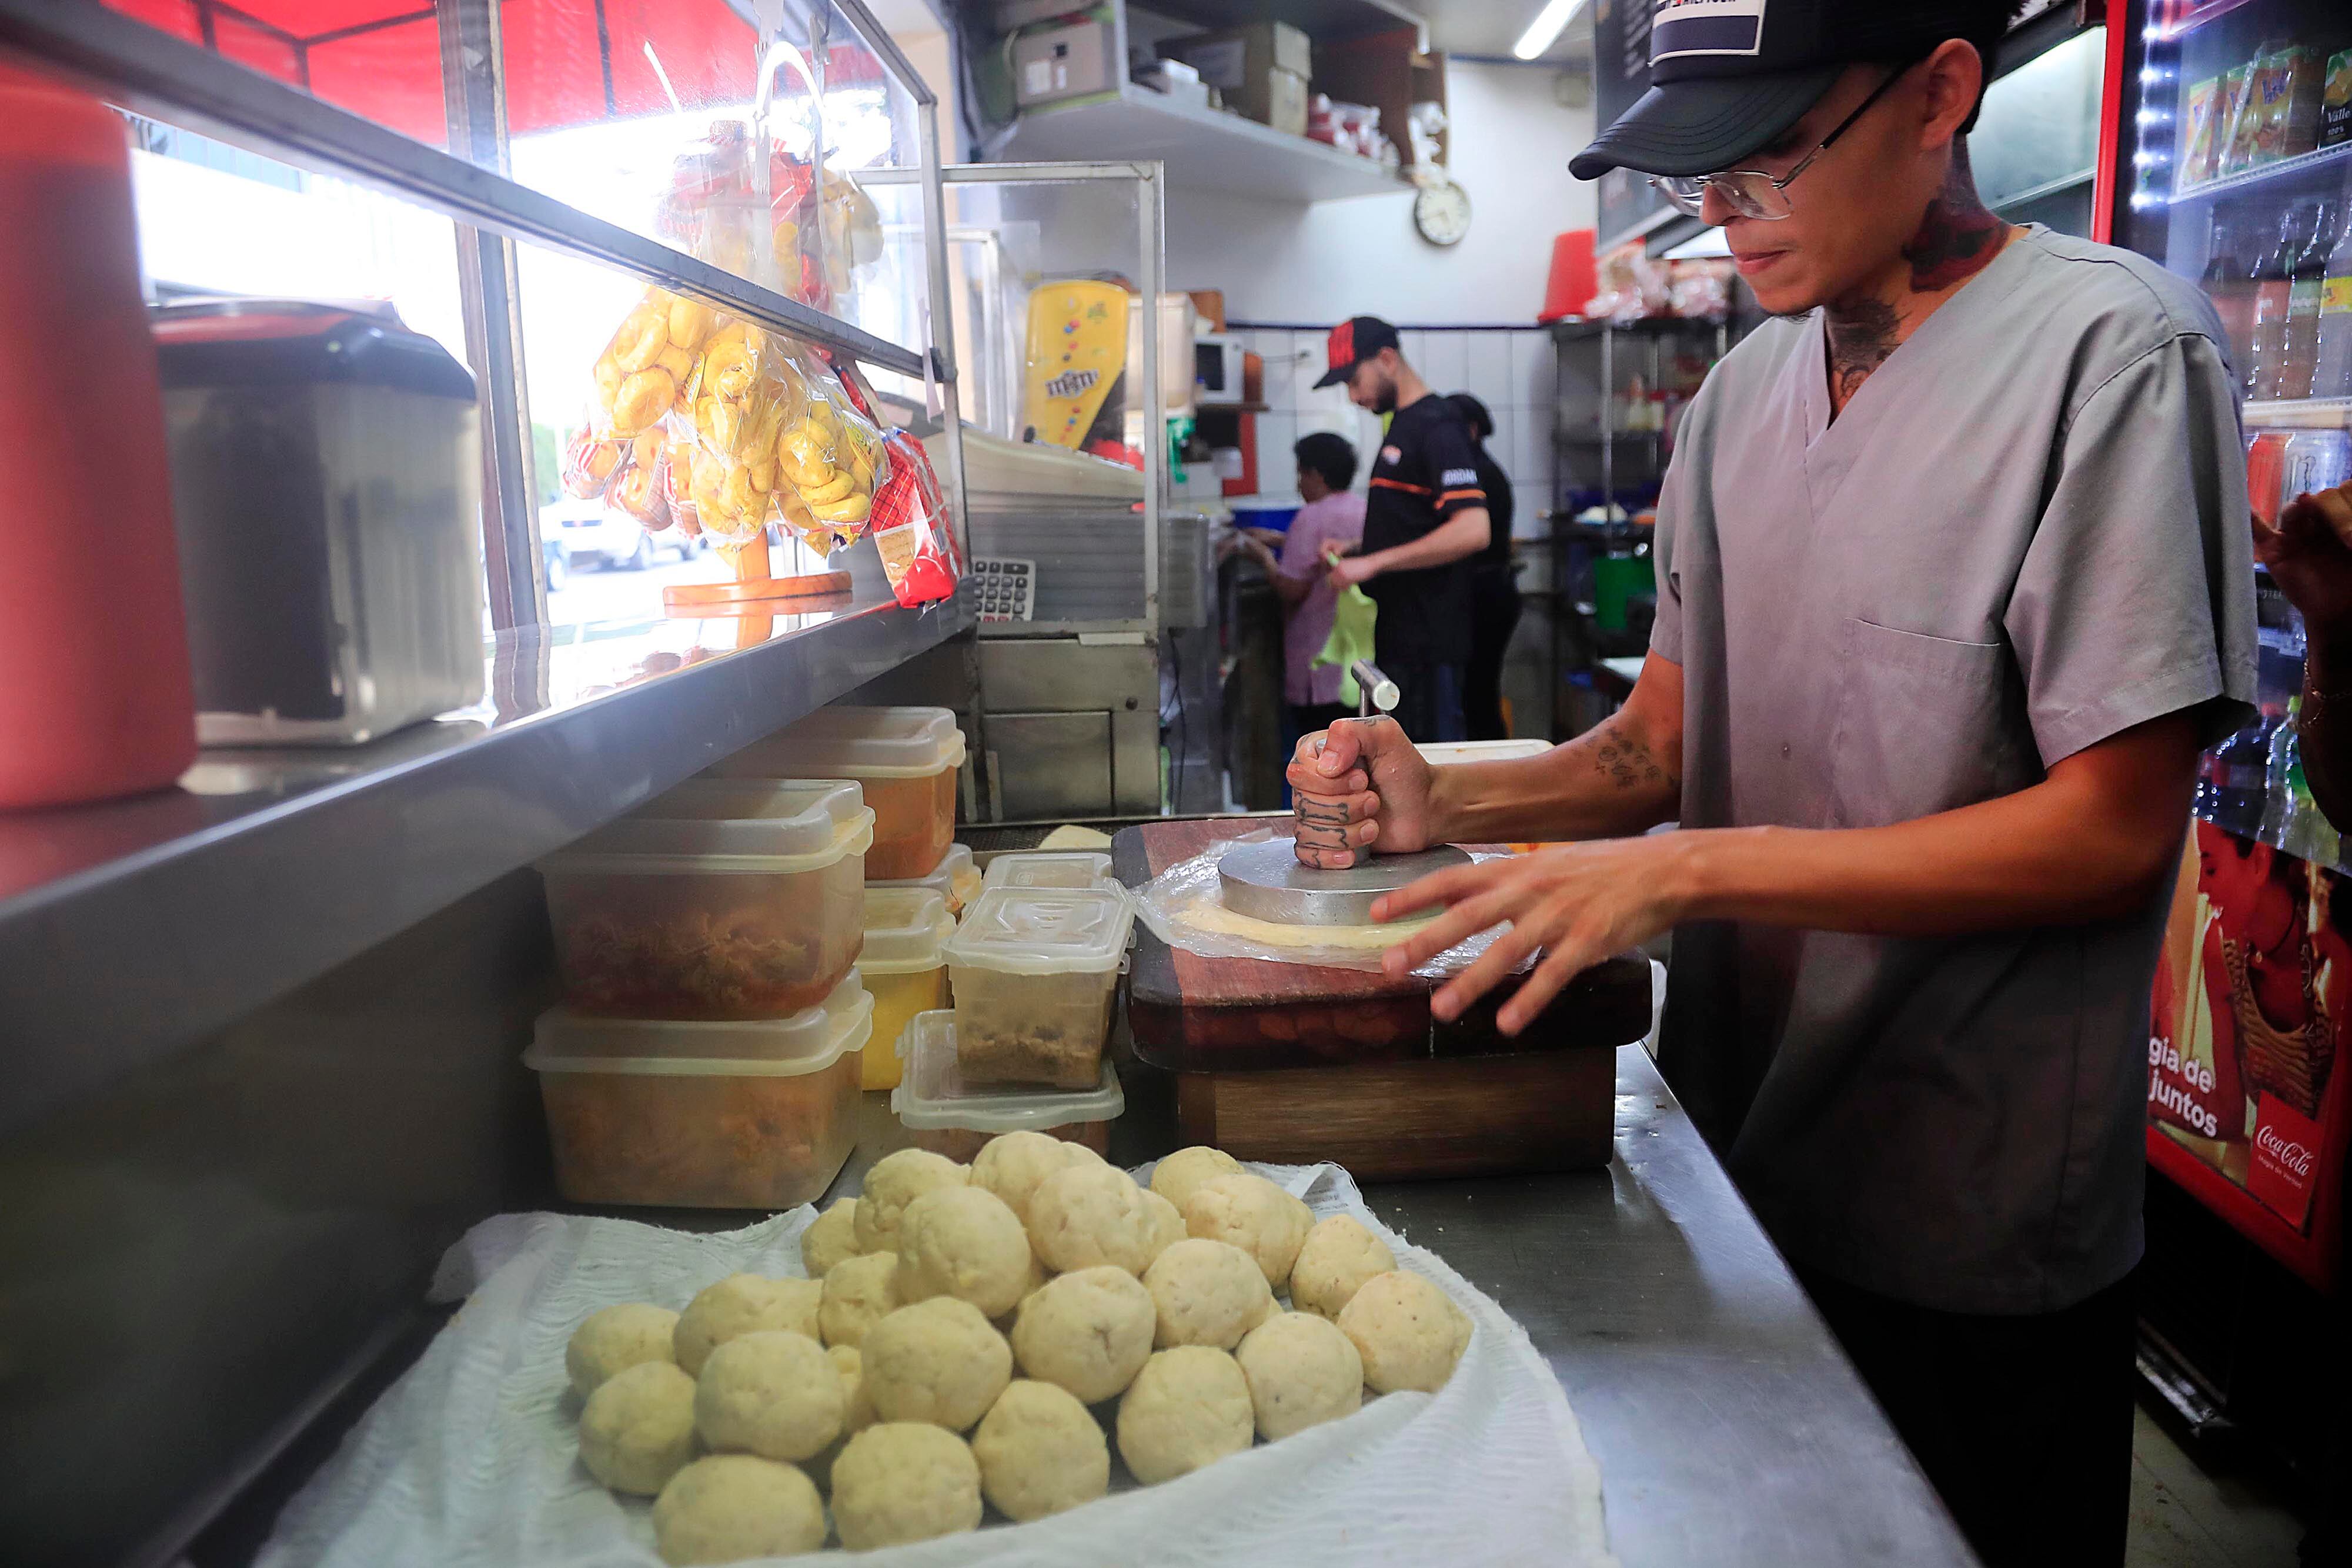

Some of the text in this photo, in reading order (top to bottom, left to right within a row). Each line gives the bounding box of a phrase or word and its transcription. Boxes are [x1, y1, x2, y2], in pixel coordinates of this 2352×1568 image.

[2149, 1037, 2211, 1094] gia de
[2149, 1068, 2217, 1138] juntos
[2257, 1125, 2314, 1176] Coca-Cola
